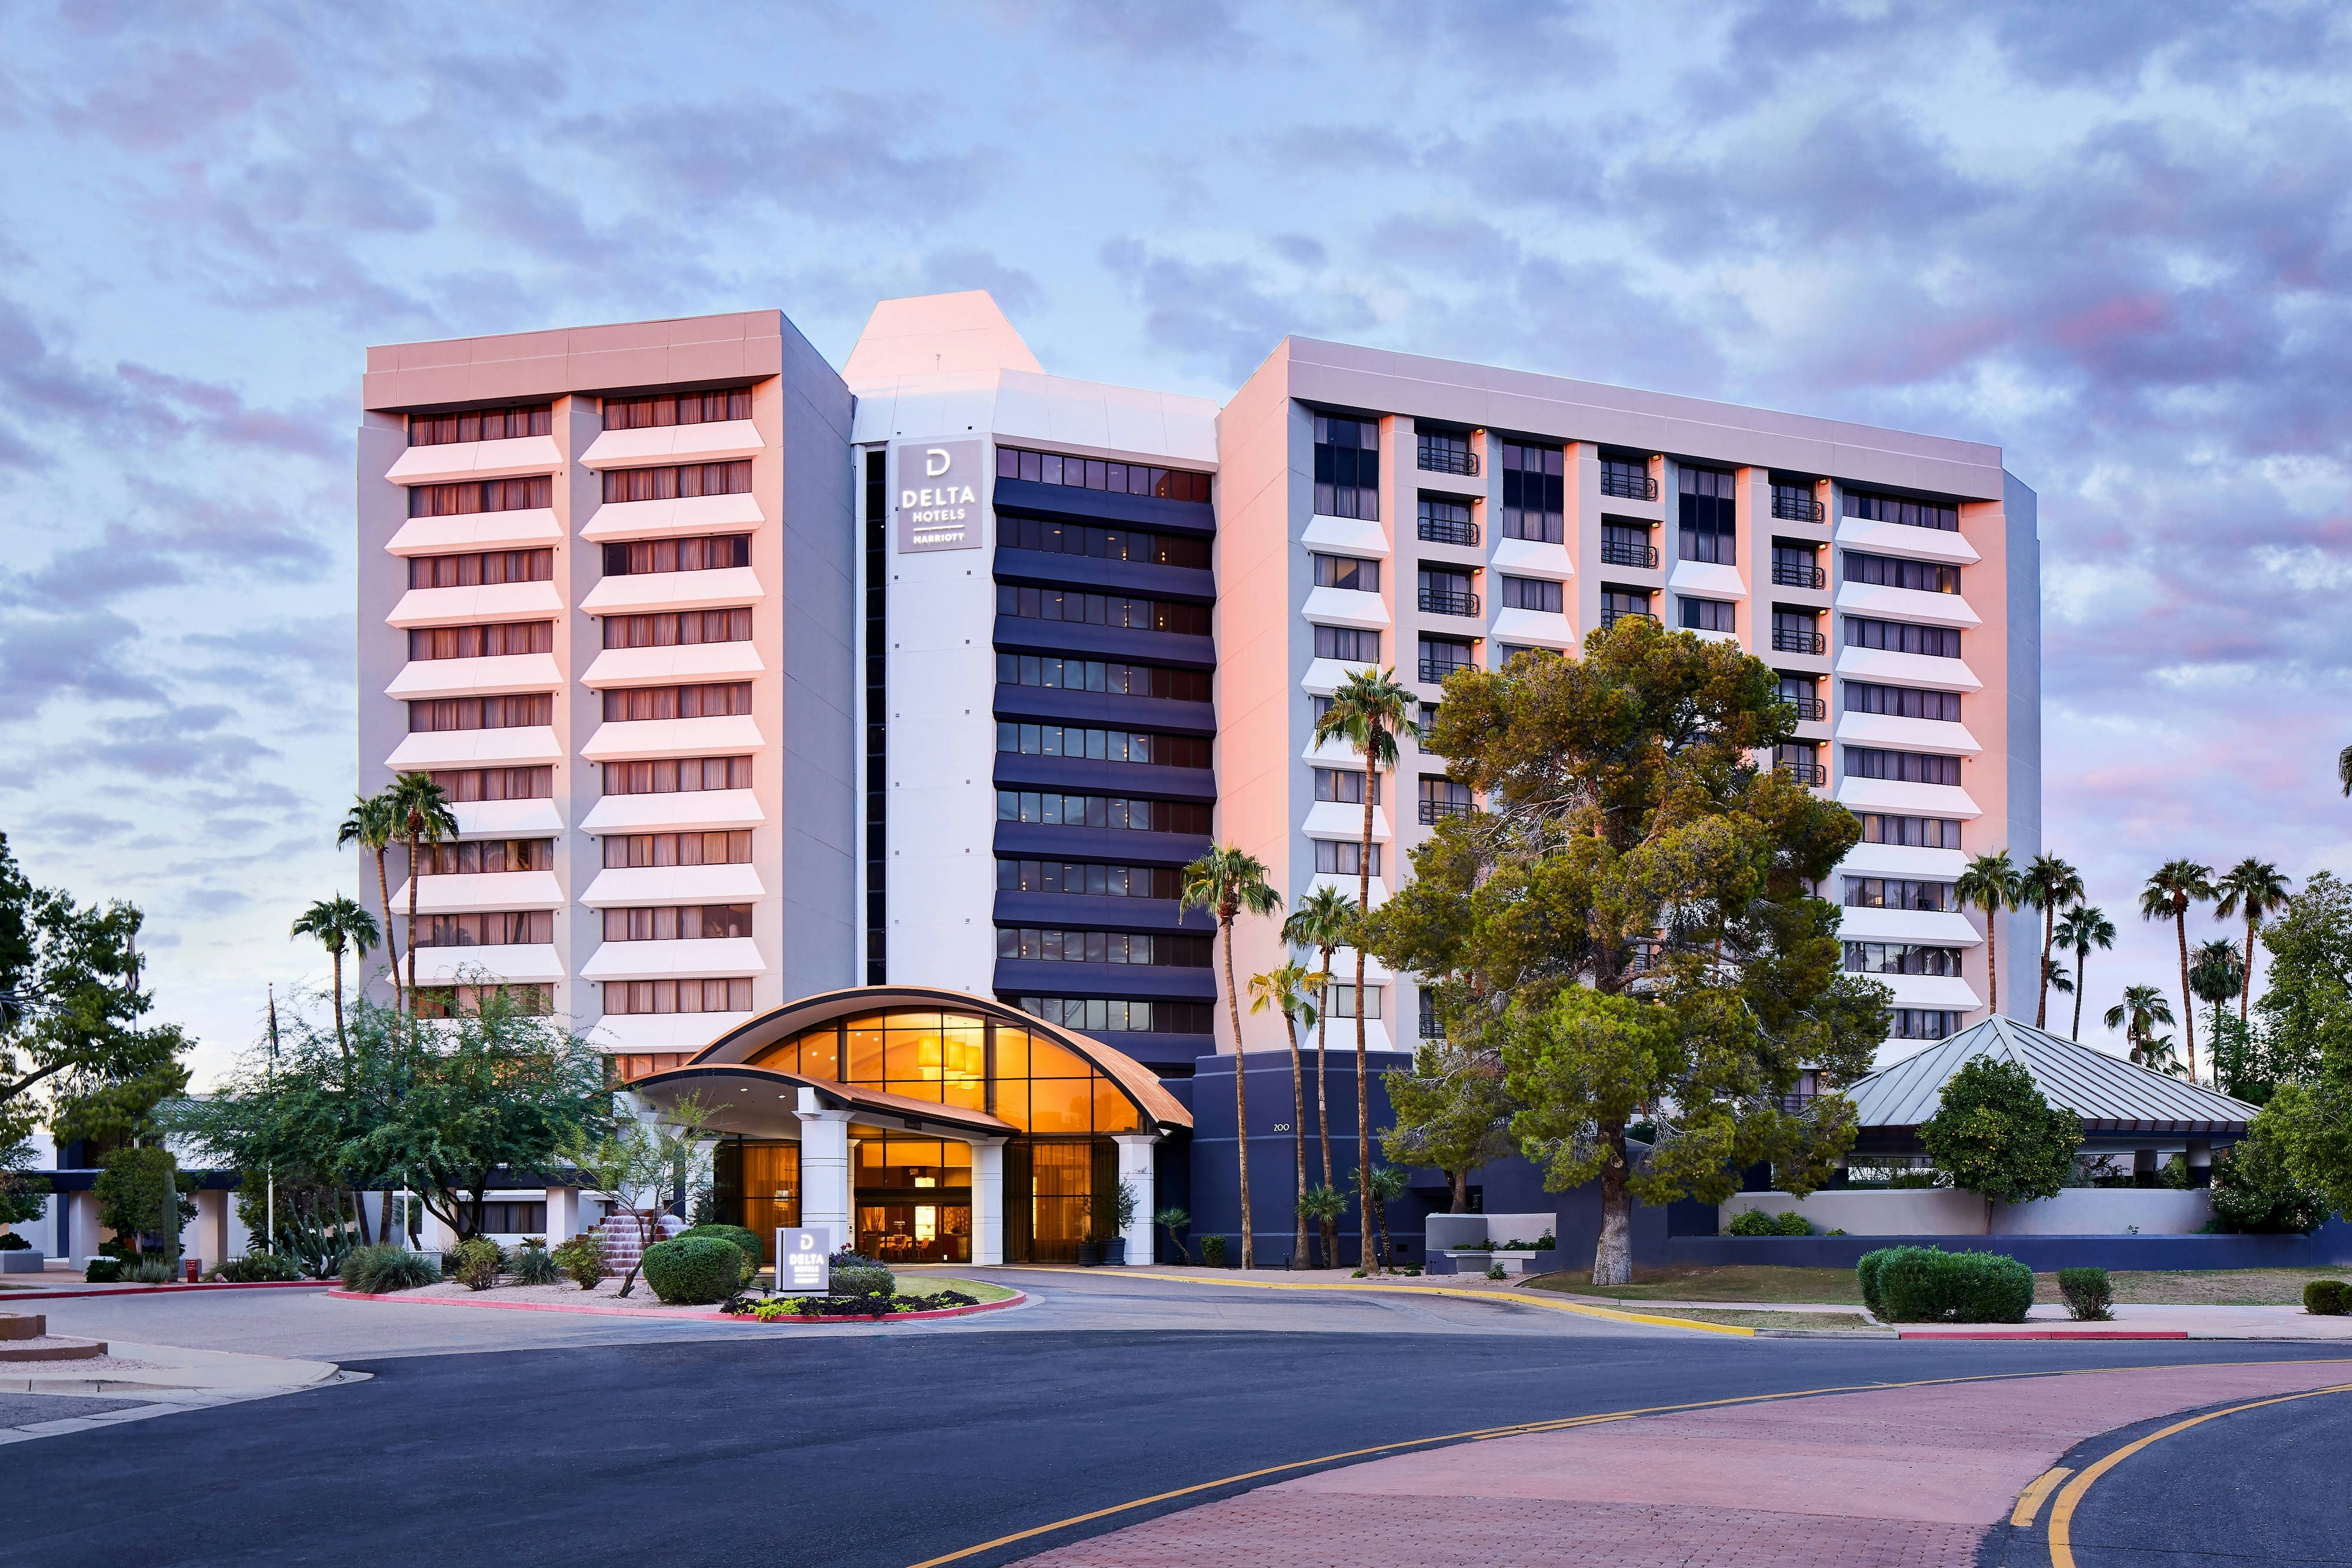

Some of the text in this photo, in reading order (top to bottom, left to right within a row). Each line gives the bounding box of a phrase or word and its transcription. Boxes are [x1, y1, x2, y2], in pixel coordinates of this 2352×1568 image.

[927, 449, 951, 476] D
[902, 486, 975, 509] DELTA
[913, 509, 965, 523] HOTELS
[913, 533, 965, 544] MARRIOTT
[1274, 1124, 1289, 1132] 200
[800, 1234, 814, 1251] D
[789, 1253, 825, 1265] DELTA
